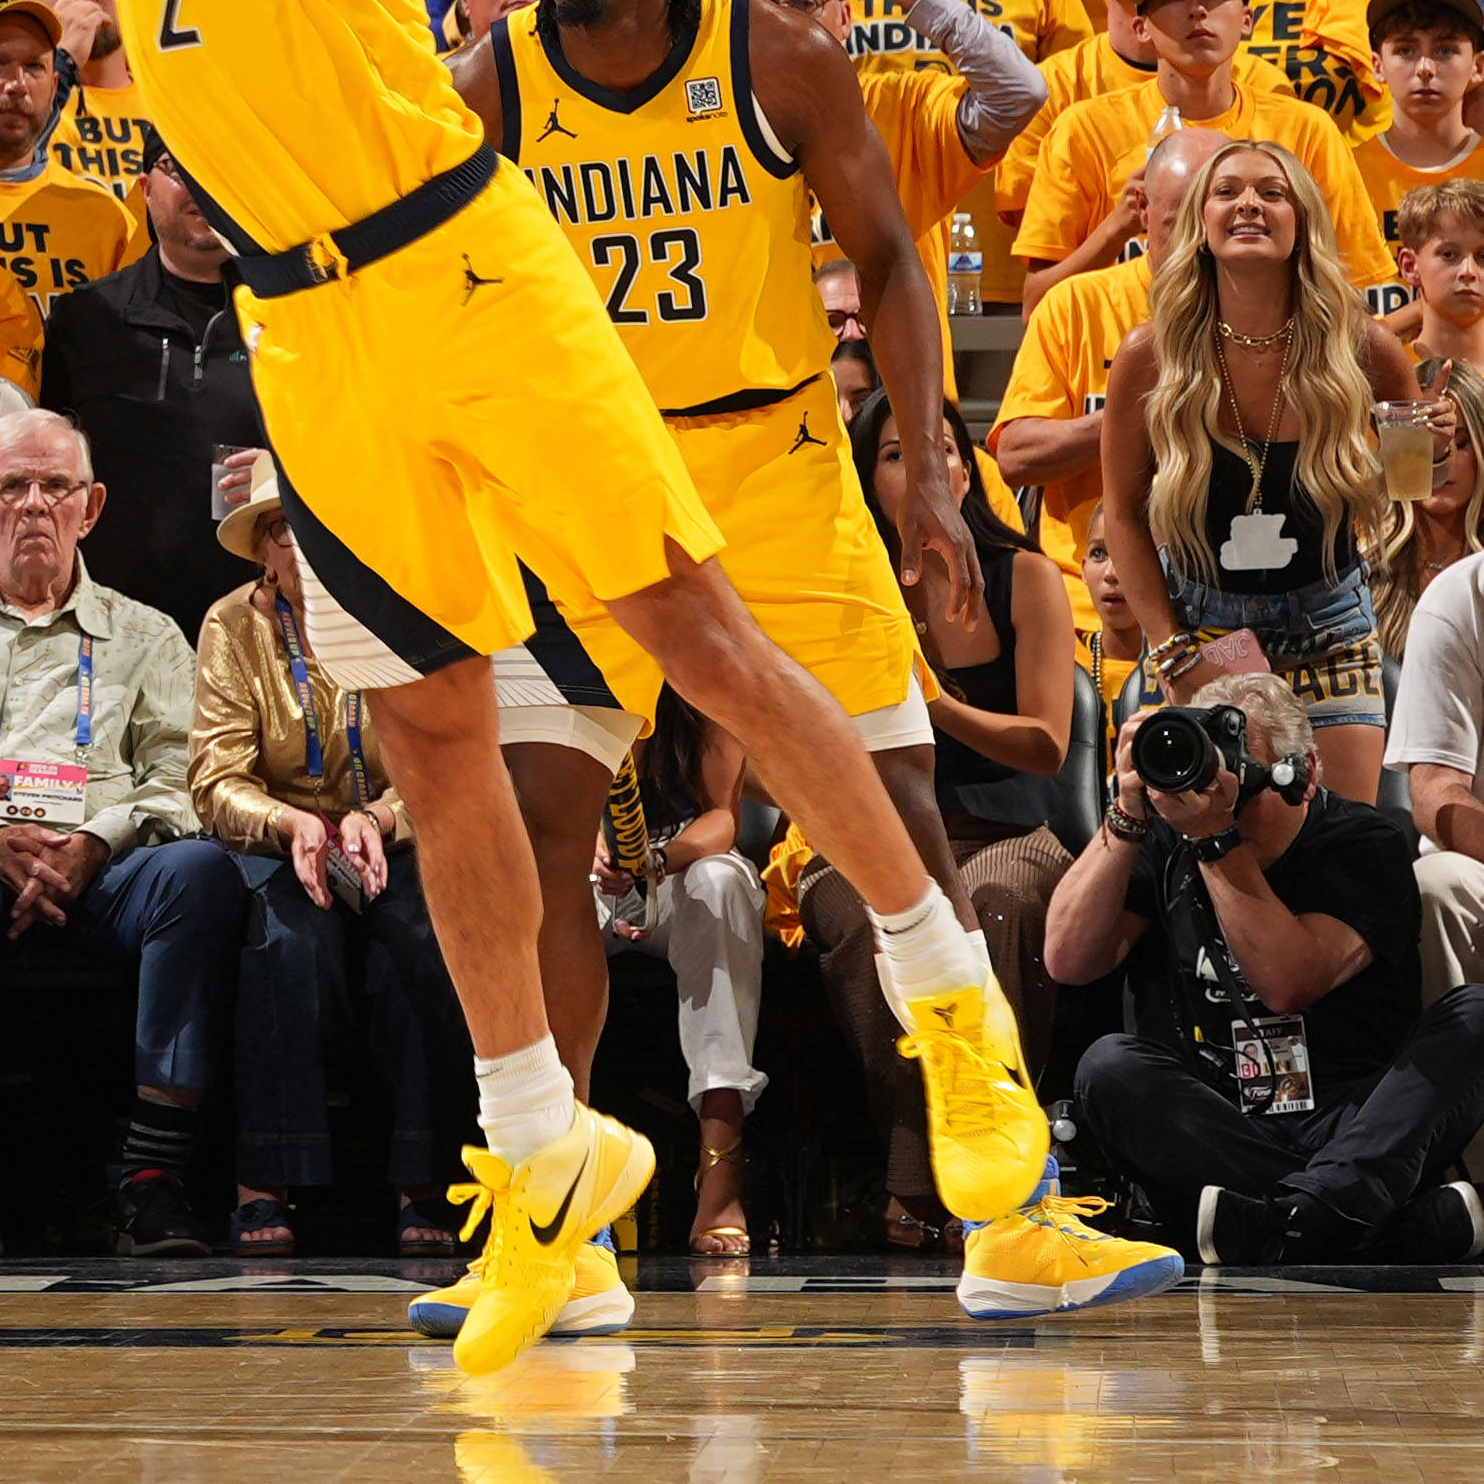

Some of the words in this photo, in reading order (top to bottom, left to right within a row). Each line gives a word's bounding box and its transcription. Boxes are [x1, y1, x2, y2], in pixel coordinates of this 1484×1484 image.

[76, 117, 154, 143] BUT
[59, 143, 143, 178] THIS
[532, 145, 753, 227] INDIANA
[51, 257, 89, 289] IS
[591, 227, 708, 327] 23
[13, 775, 74, 790] FAMILY
